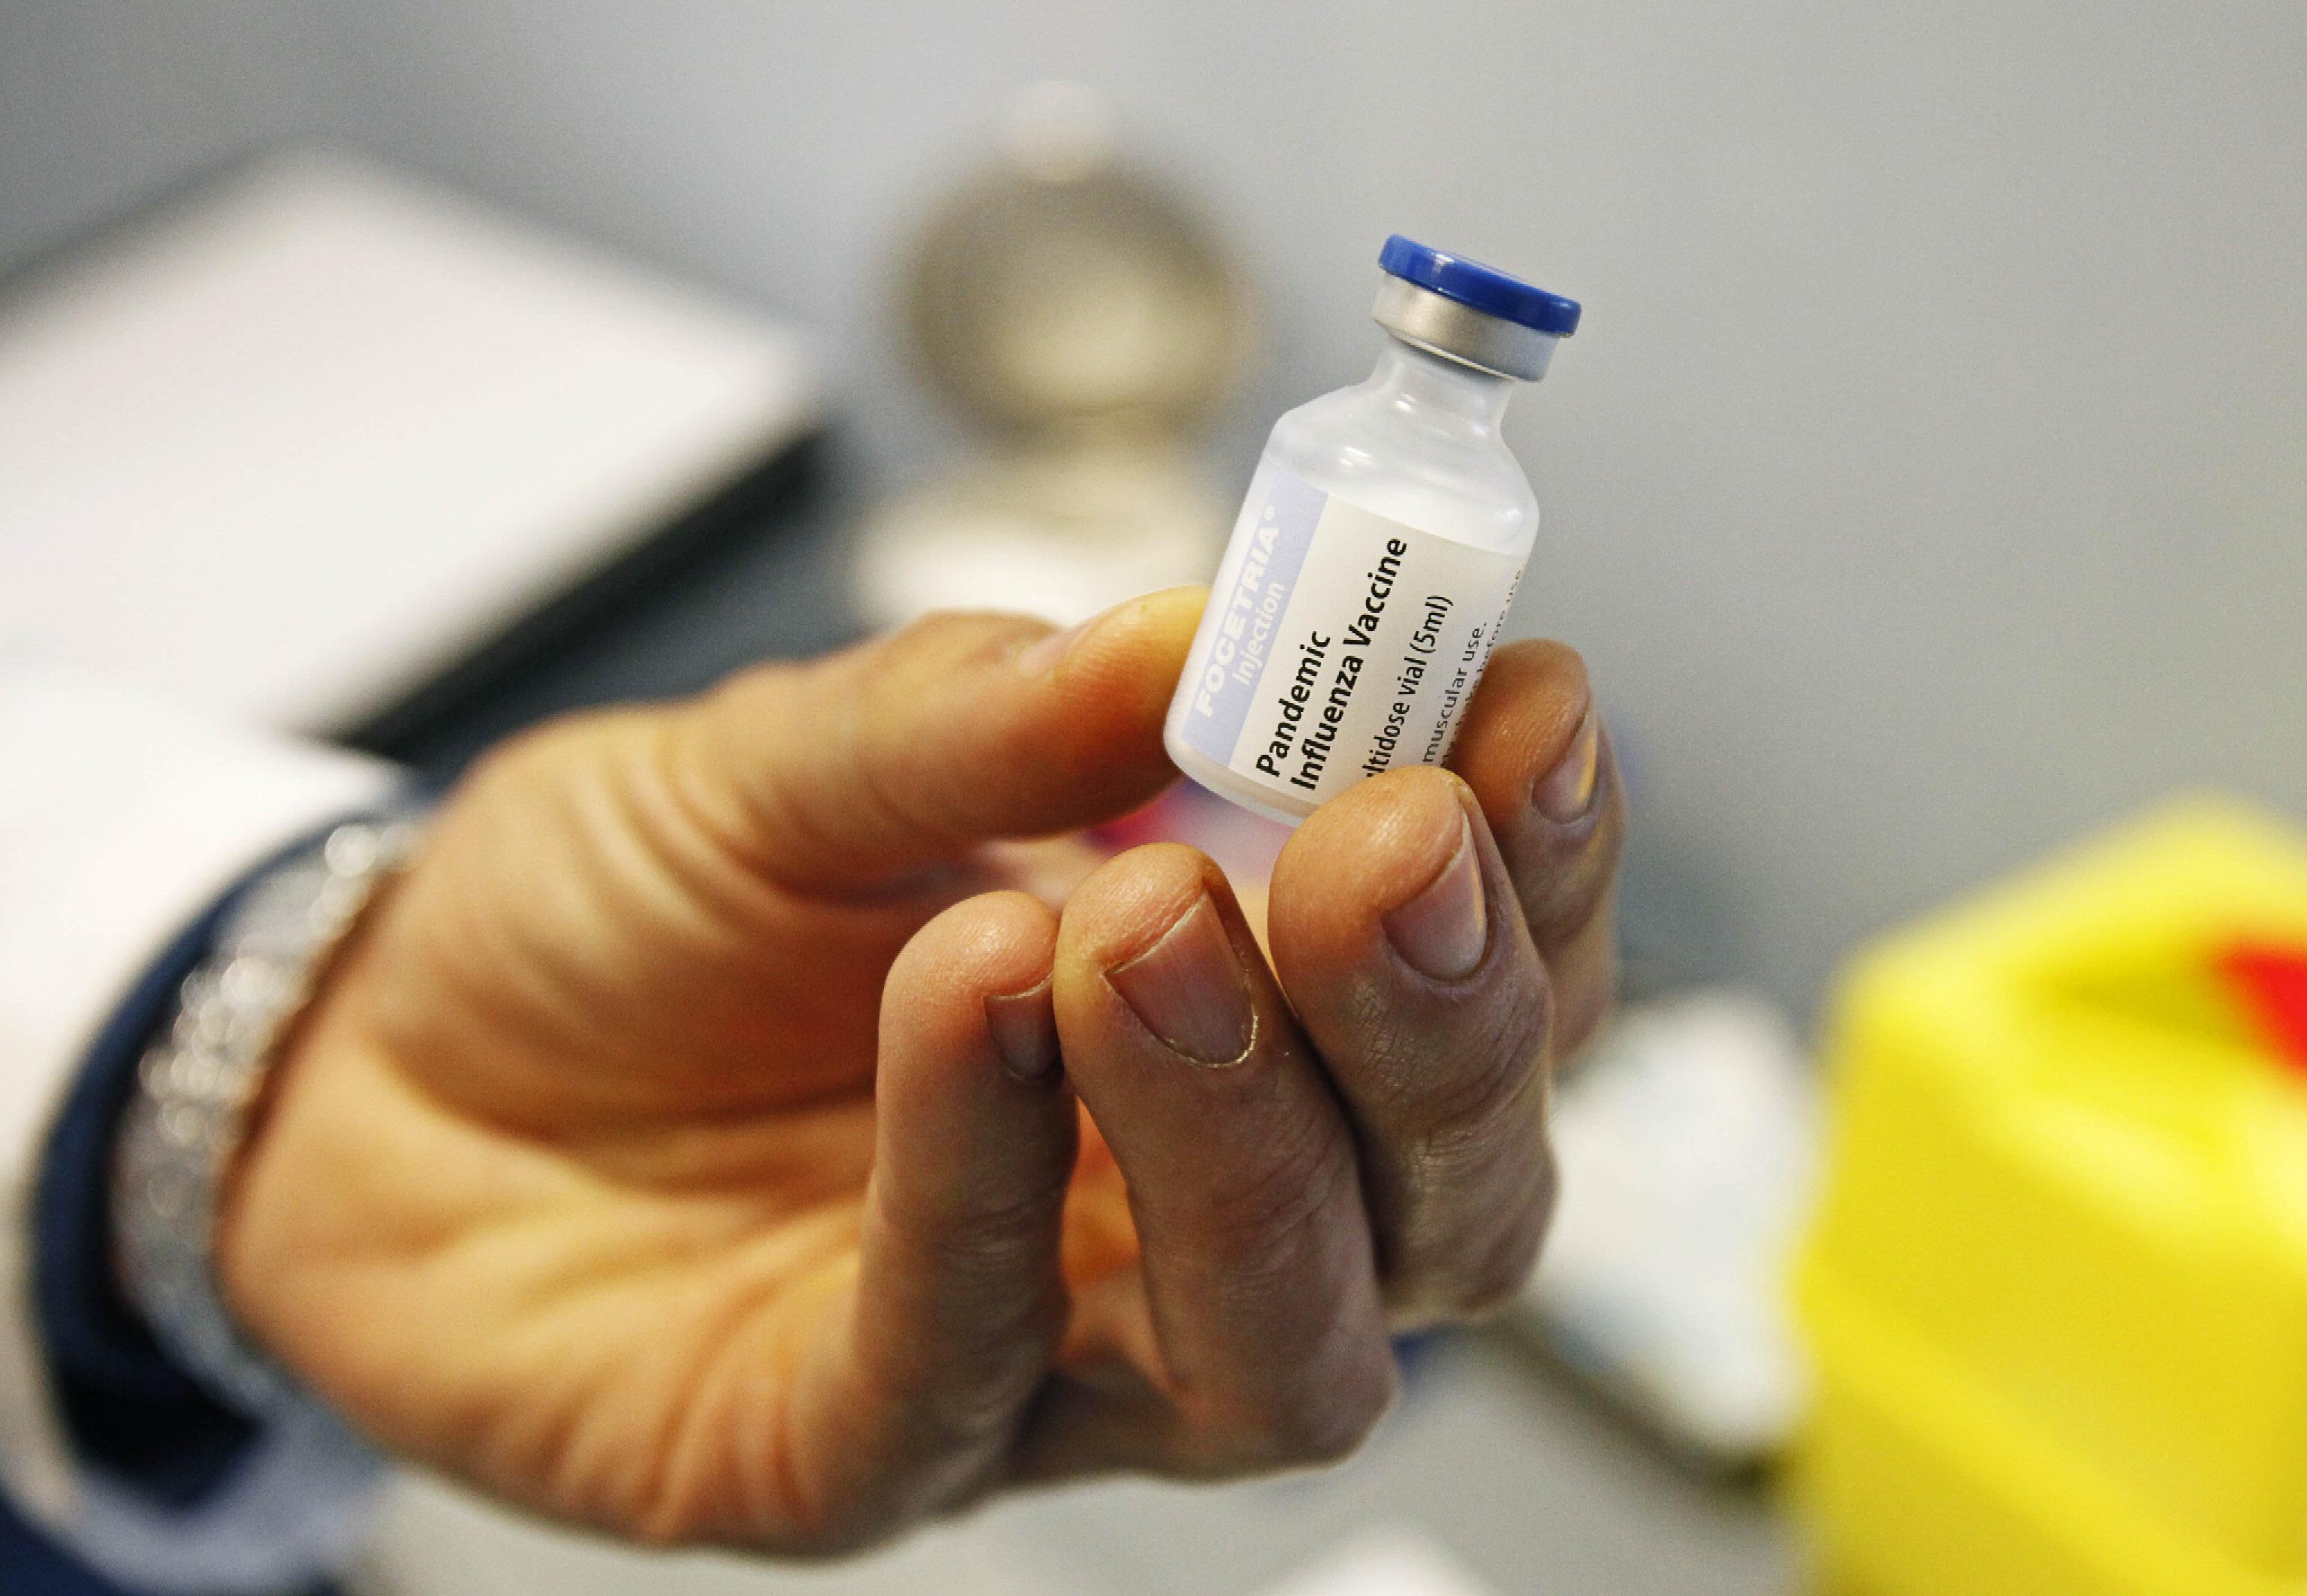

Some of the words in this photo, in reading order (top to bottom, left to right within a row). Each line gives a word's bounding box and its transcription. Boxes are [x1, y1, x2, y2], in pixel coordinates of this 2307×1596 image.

[1232, 581, 1285, 685] Injection
[1410, 596, 1454, 653] (5ml)
[1462, 621, 1488, 661] use.
[1290, 656, 1364, 790] Influenza
[1343, 539, 1407, 647] Vaccine
[1398, 656, 1427, 695] vial
[1256, 631, 1330, 777] Pandemic
[1362, 702, 1410, 777] ltidose
